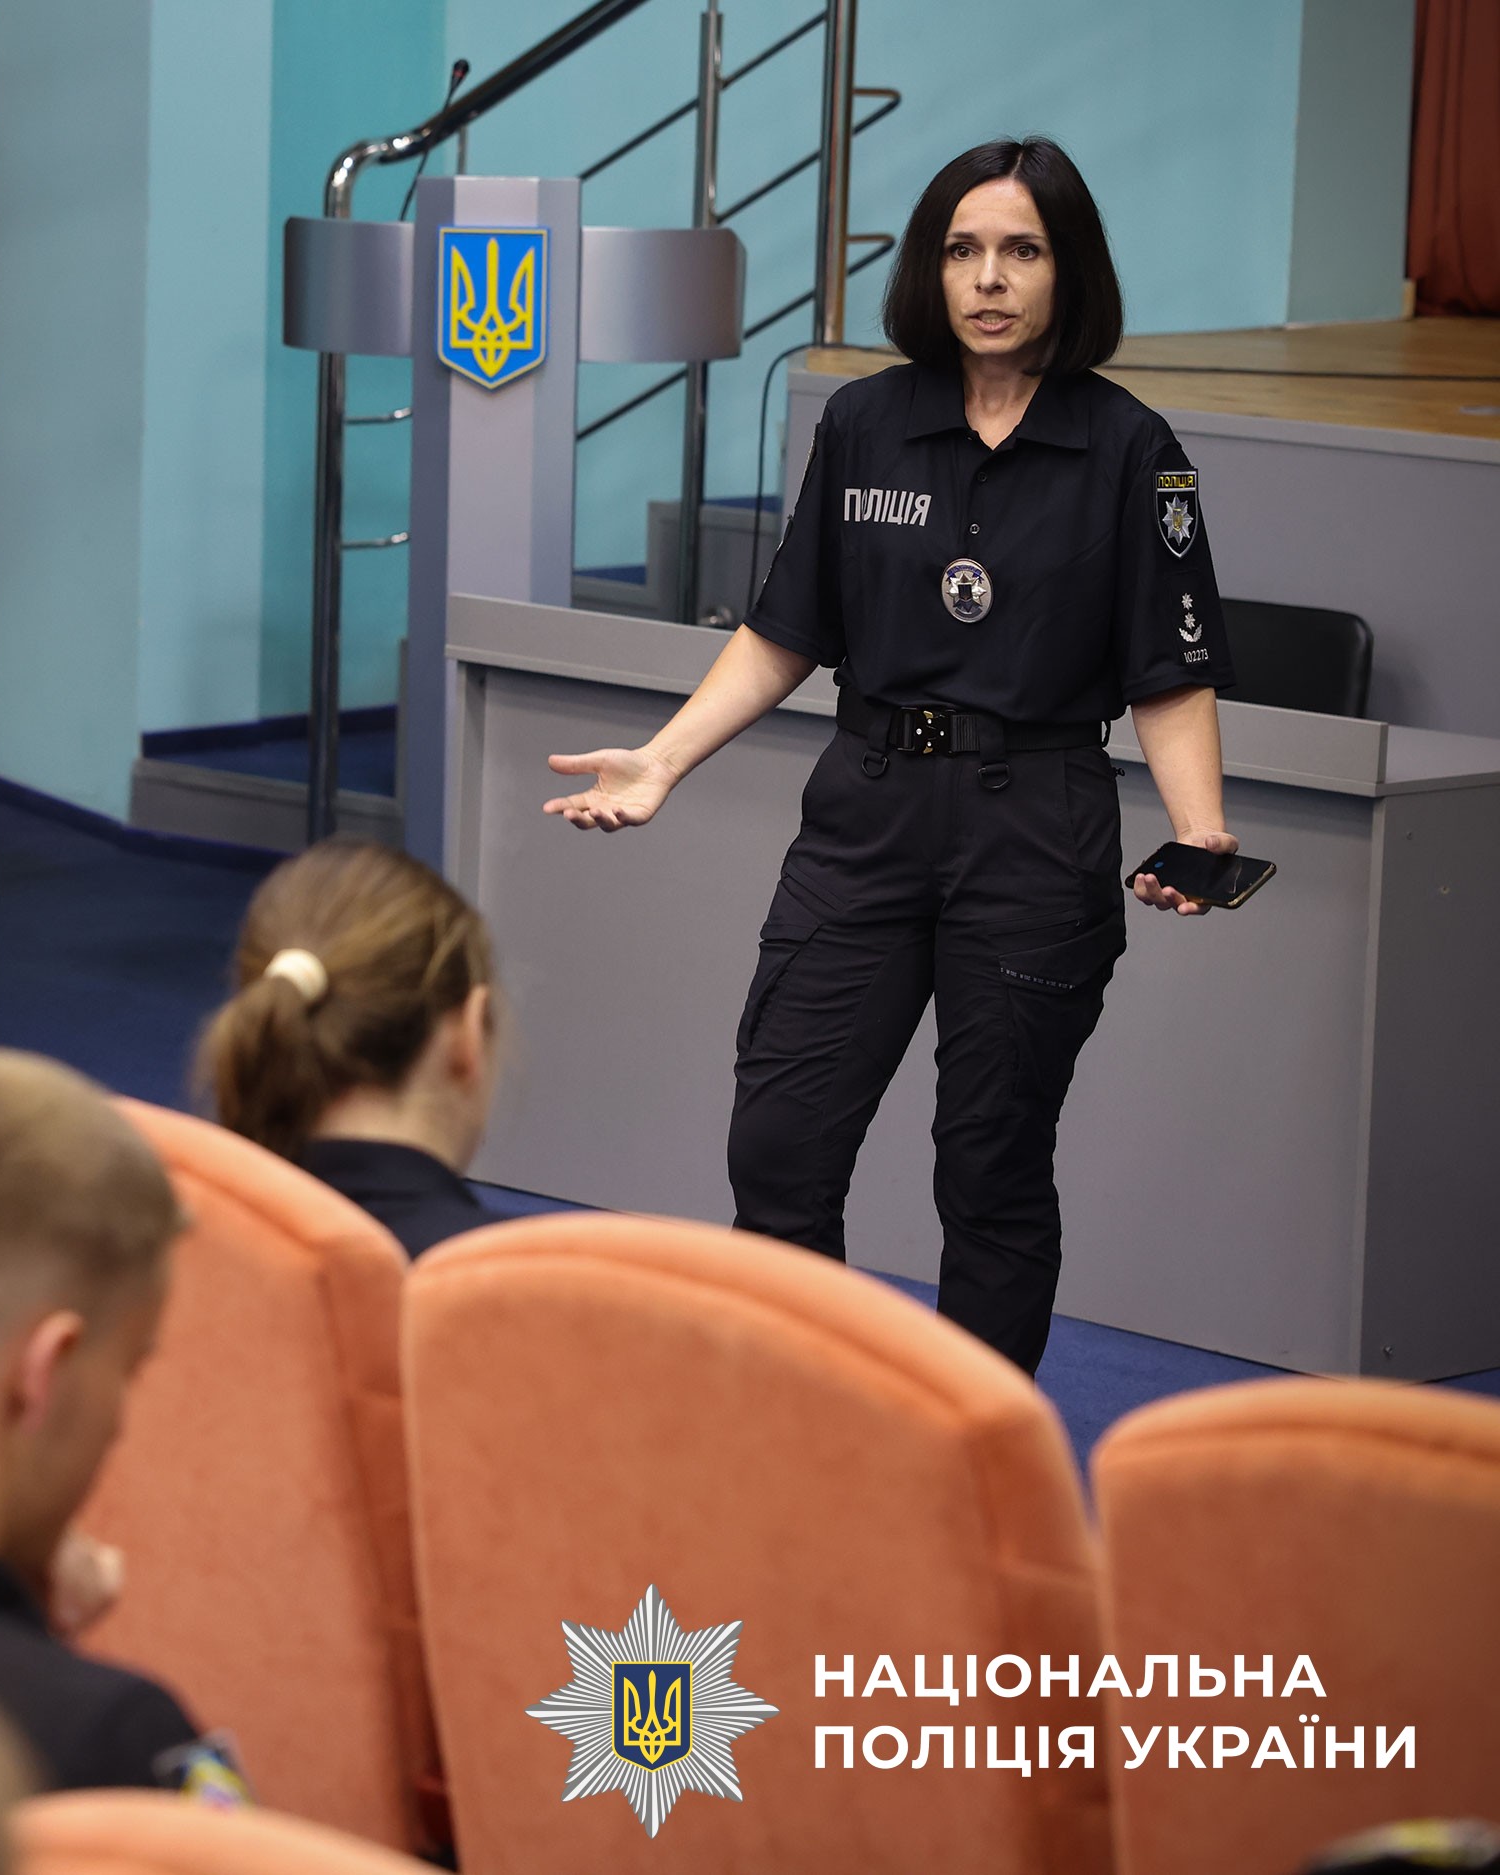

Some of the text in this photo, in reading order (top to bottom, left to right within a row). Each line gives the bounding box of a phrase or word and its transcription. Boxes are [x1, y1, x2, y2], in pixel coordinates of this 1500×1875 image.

[1156, 475, 1194, 488] ПОЛІЦІЯ
[843, 488, 932, 527] ПОЛІЦІЯ
[1184, 648, 1209, 663] 102273
